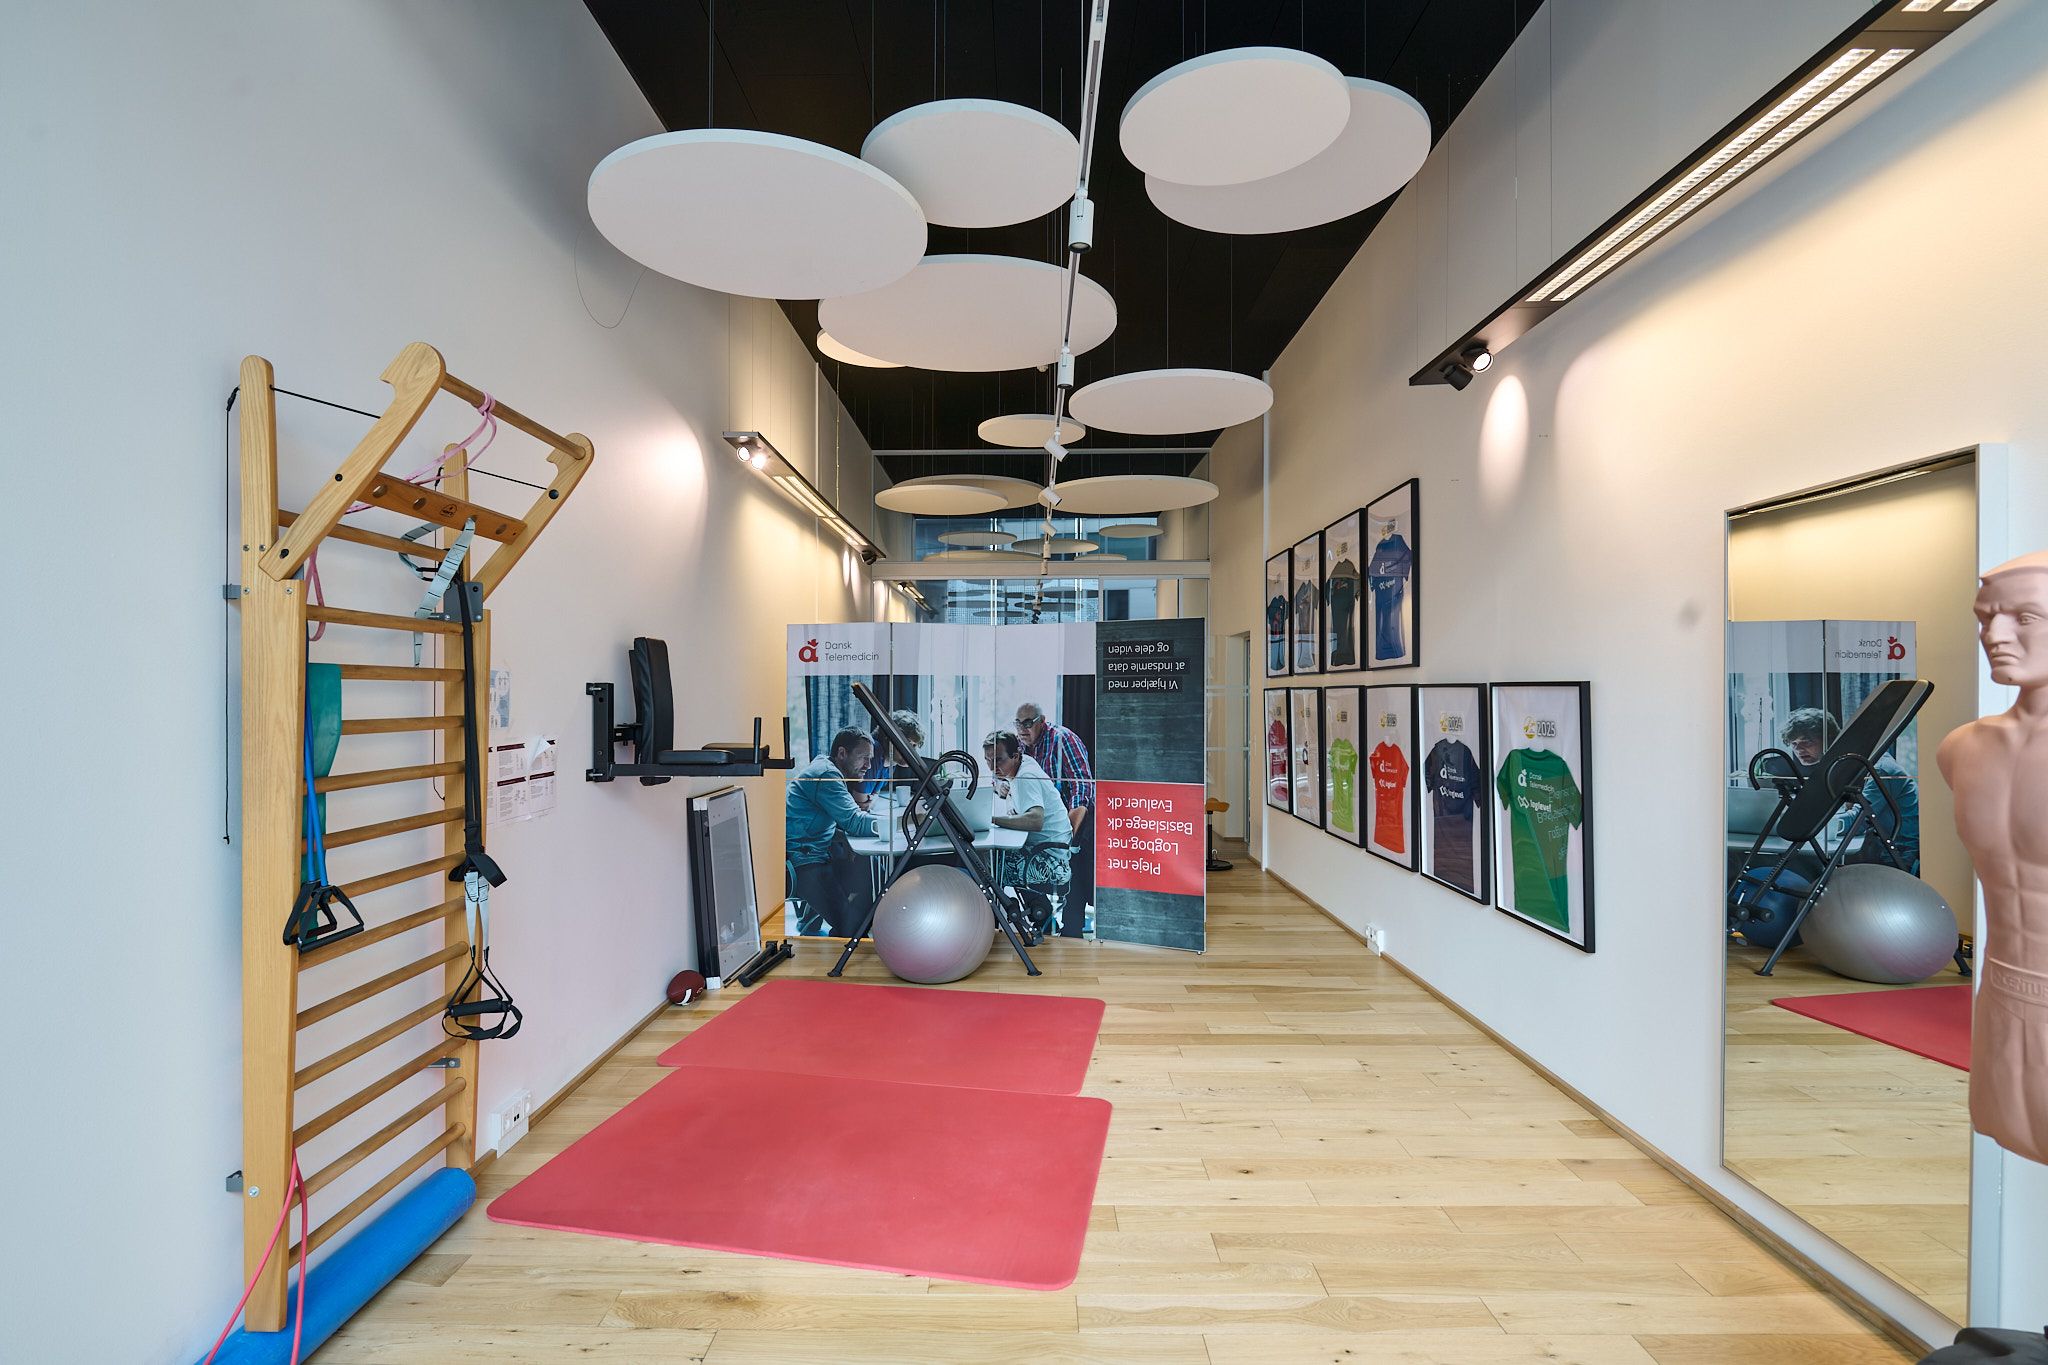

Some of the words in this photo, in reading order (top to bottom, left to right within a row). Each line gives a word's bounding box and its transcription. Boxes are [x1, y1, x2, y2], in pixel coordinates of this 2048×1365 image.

[825, 641, 852, 649] Dansk
[1108, 645, 1133, 655] viden
[1135, 645, 1155, 654] dele
[1157, 642, 1169, 652] og
[825, 652, 879, 662] Telemedicin
[1108, 663, 1129, 672] data
[1131, 662, 1173, 672] indsamle
[1176, 662, 1186, 670] at
[1108, 680, 1129, 690] med
[1131, 678, 1167, 690] hjælper
[1169, 680, 1179, 690] Vi
[1536, 720, 1557, 737] 2025
[1107, 797, 1173, 812] Evaluer.dk
[1530, 799, 1552, 812] loglevel
[1107, 816, 1193, 835] Basislaege.dk
[1107, 836, 1179, 855] Logbog.net
[1107, 858, 1161, 875] Pleje.net
